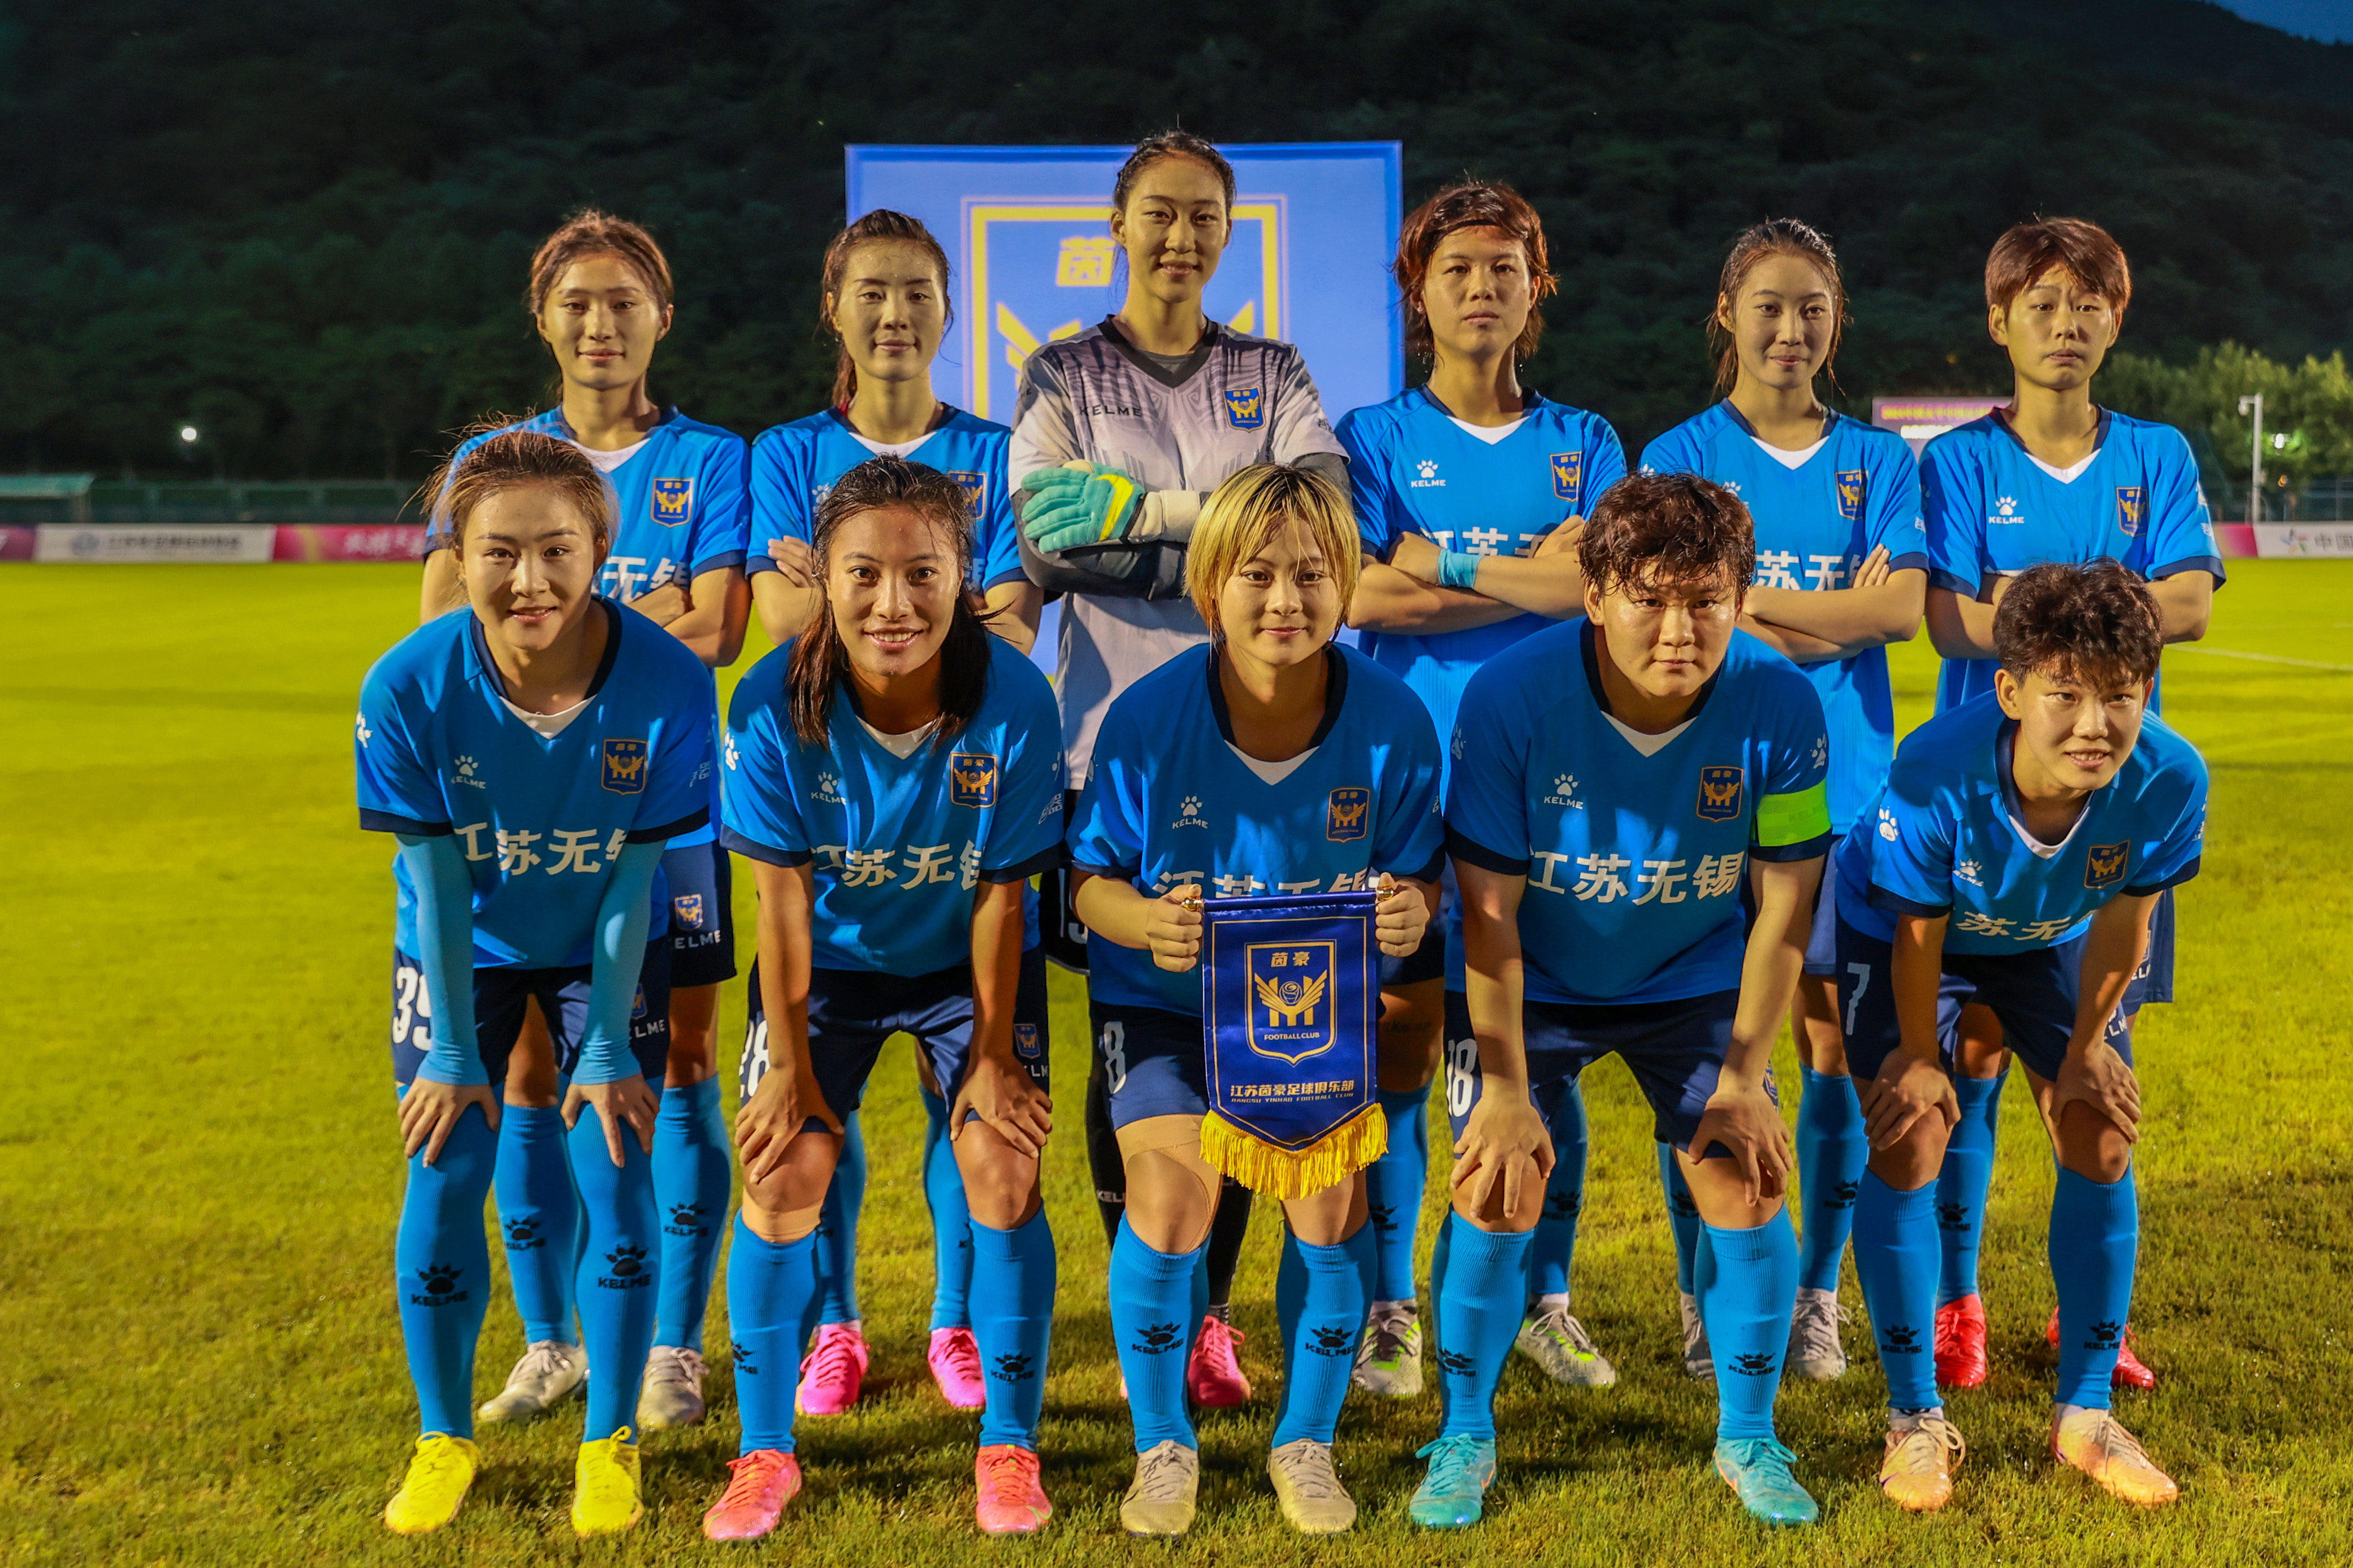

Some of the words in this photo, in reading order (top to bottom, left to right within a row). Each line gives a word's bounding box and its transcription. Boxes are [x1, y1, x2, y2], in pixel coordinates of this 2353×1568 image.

[1079, 405, 1143, 418] KELME
[1411, 479, 1446, 488] KELME
[1988, 516, 2025, 525] KELME
[1543, 795, 1584, 809] KELME
[1172, 818, 1208, 829] KELME
[671, 930, 721, 950] ELME
[1271, 951, 1310, 967] 茵豪
[1846, 962, 1871, 1036] 7
[1230, 1080, 1355, 1098] 江苏茵豪足球俱乐部
[598, 1273, 652, 1290] KELME
[412, 1289, 468, 1307] KELME
[1132, 1338, 1184, 1355] KELME
[1305, 1342, 1355, 1357] KELME
[1881, 1344, 1923, 1354] KELME
[990, 1370, 1035, 1382] KELME
[1728, 1363, 1776, 1376] KELME
